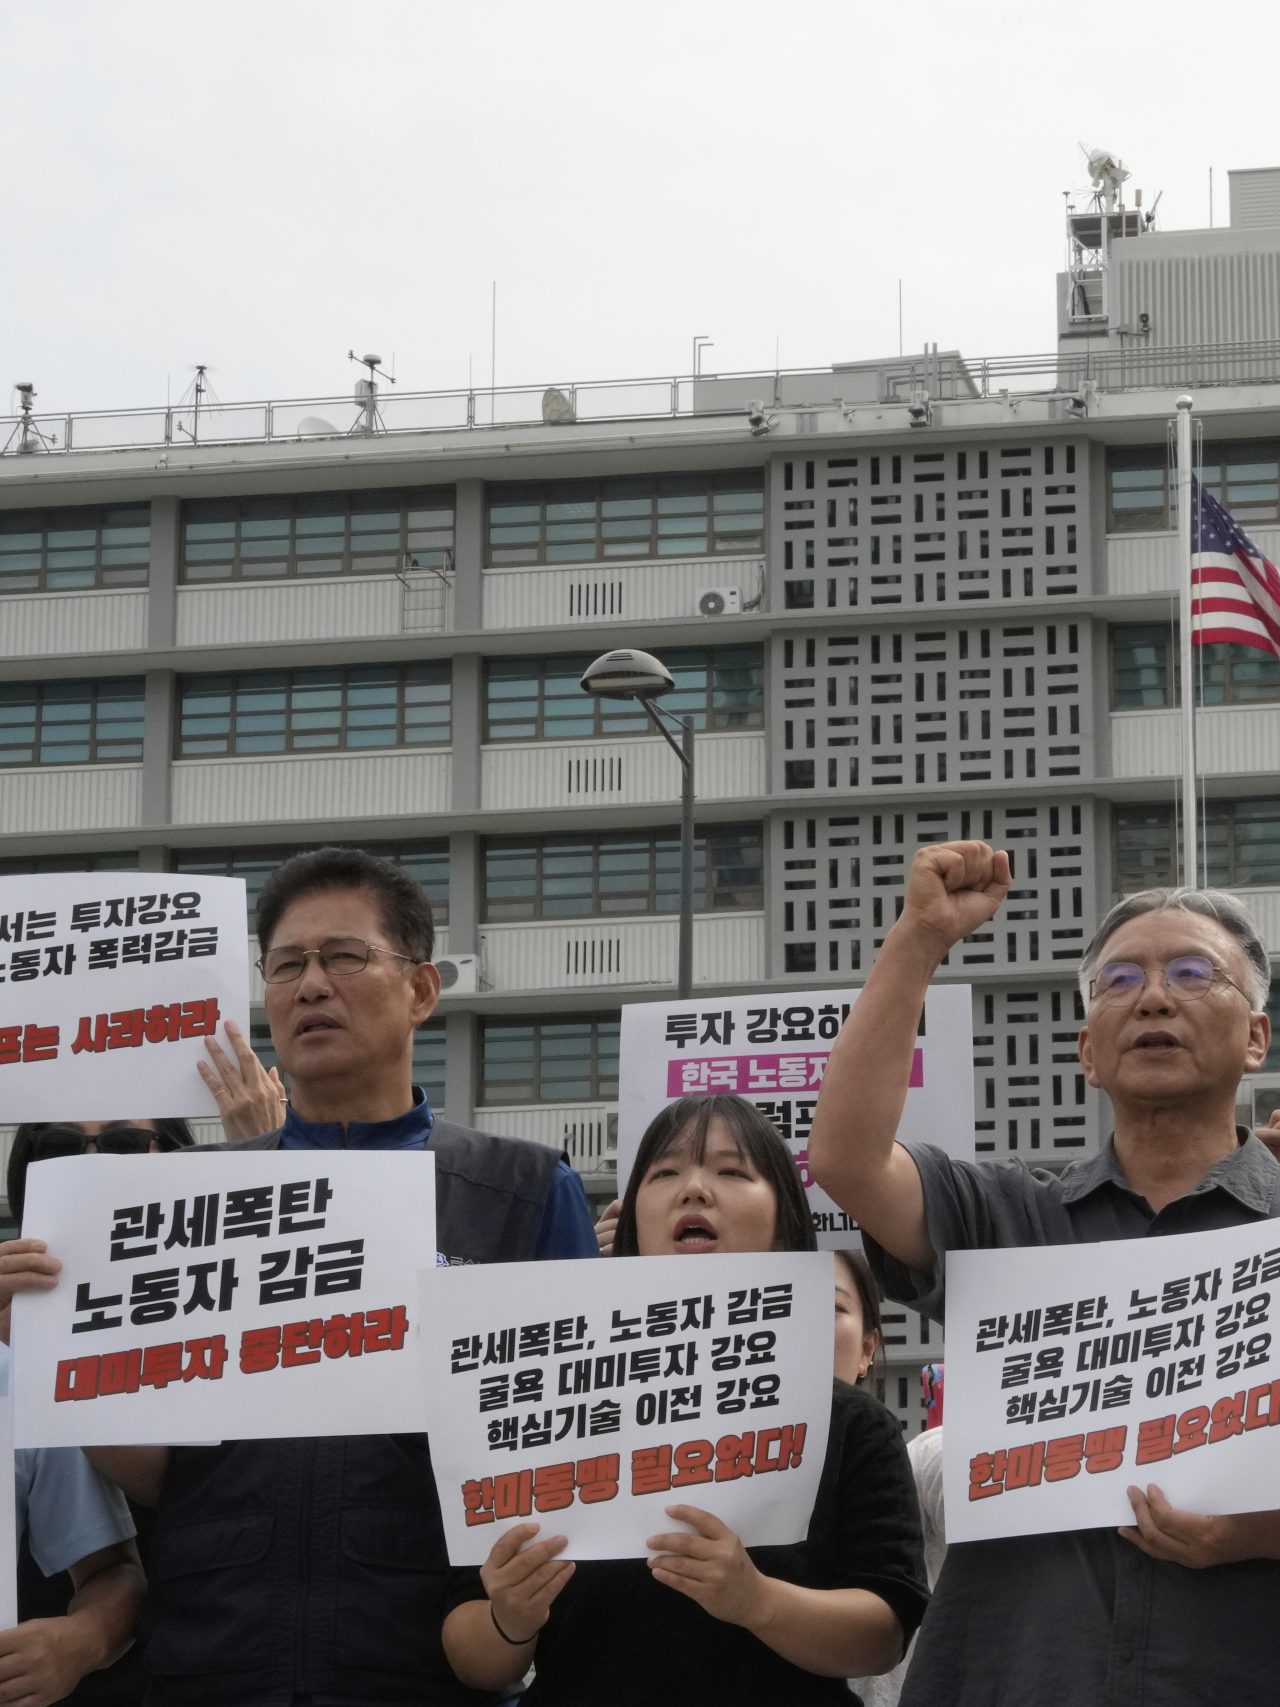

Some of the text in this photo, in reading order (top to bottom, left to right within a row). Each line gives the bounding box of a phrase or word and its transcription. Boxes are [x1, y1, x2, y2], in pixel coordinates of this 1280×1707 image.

[70, 891, 201, 933] 투자강요
[0, 926, 219, 983] 동자 폭력감금
[70, 997, 221, 1055] 사과하라
[665, 1010, 735, 1049] 투자
[681, 1058, 738, 1094] 한국
[109, 1177, 333, 1262] 관세폭탄
[71, 1238, 365, 1334] 노동자 감금
[975, 1294, 1113, 1353] 관세폭탄,
[1127, 1266, 1222, 1321] 노동자
[54, 1305, 409, 1403] 대미투자 중단하라
[450, 1283, 793, 1374] 관세폭탄, 노동자 감금
[1000, 1292, 1272, 1390] 굴욕 대미투자 강요
[479, 1330, 776, 1413] 굴욕 대미투자 강요
[487, 1373, 780, 1453] 핵심기술 이전 강요
[1005, 1332, 1273, 1426] 핵심기술 이전 강요
[460, 1422, 807, 1527] 한미동맹 필요없다!
[968, 1424, 1128, 1502] 한미동맹
